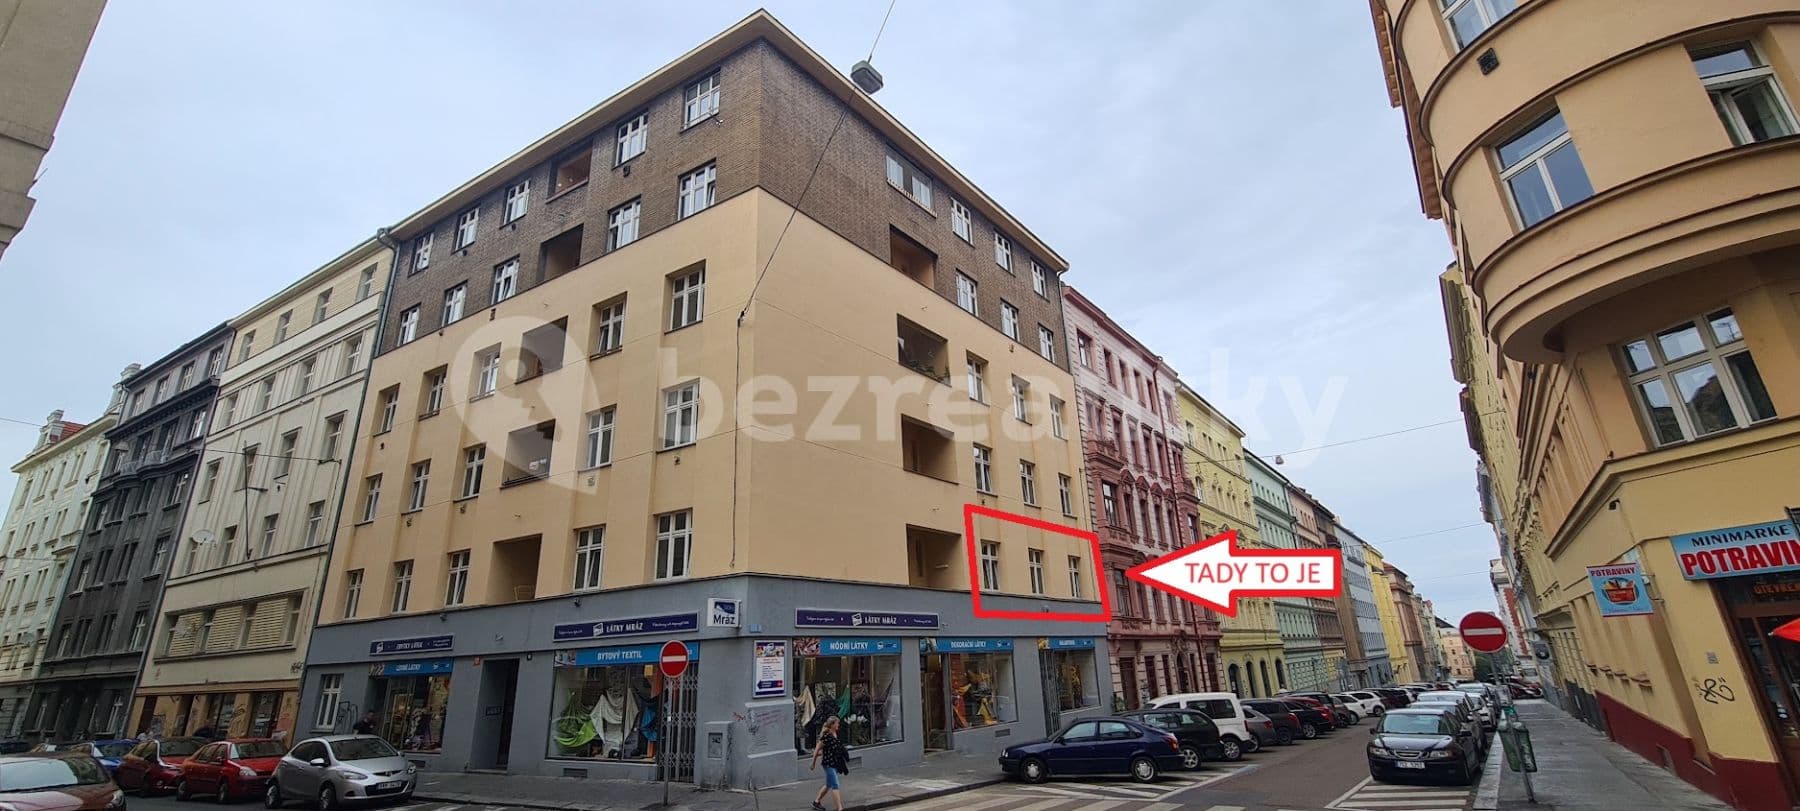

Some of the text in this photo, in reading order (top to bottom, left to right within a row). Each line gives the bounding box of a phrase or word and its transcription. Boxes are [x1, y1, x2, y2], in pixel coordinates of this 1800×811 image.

[1691, 523, 1792, 547] MINIMARKE
[1590, 567, 1635, 577] POTRAVINY
[713, 613, 736, 625] Mráz
[864, 616, 897, 625] LÁTKY MRÁZ
[606, 624, 624, 633] LÁTKY
[625, 621, 644, 631] MRÁZ
[830, 641, 869, 650] MÓDNÍ LÁTKY
[597, 650, 642, 661] BYTOVÝ TEXTIL
